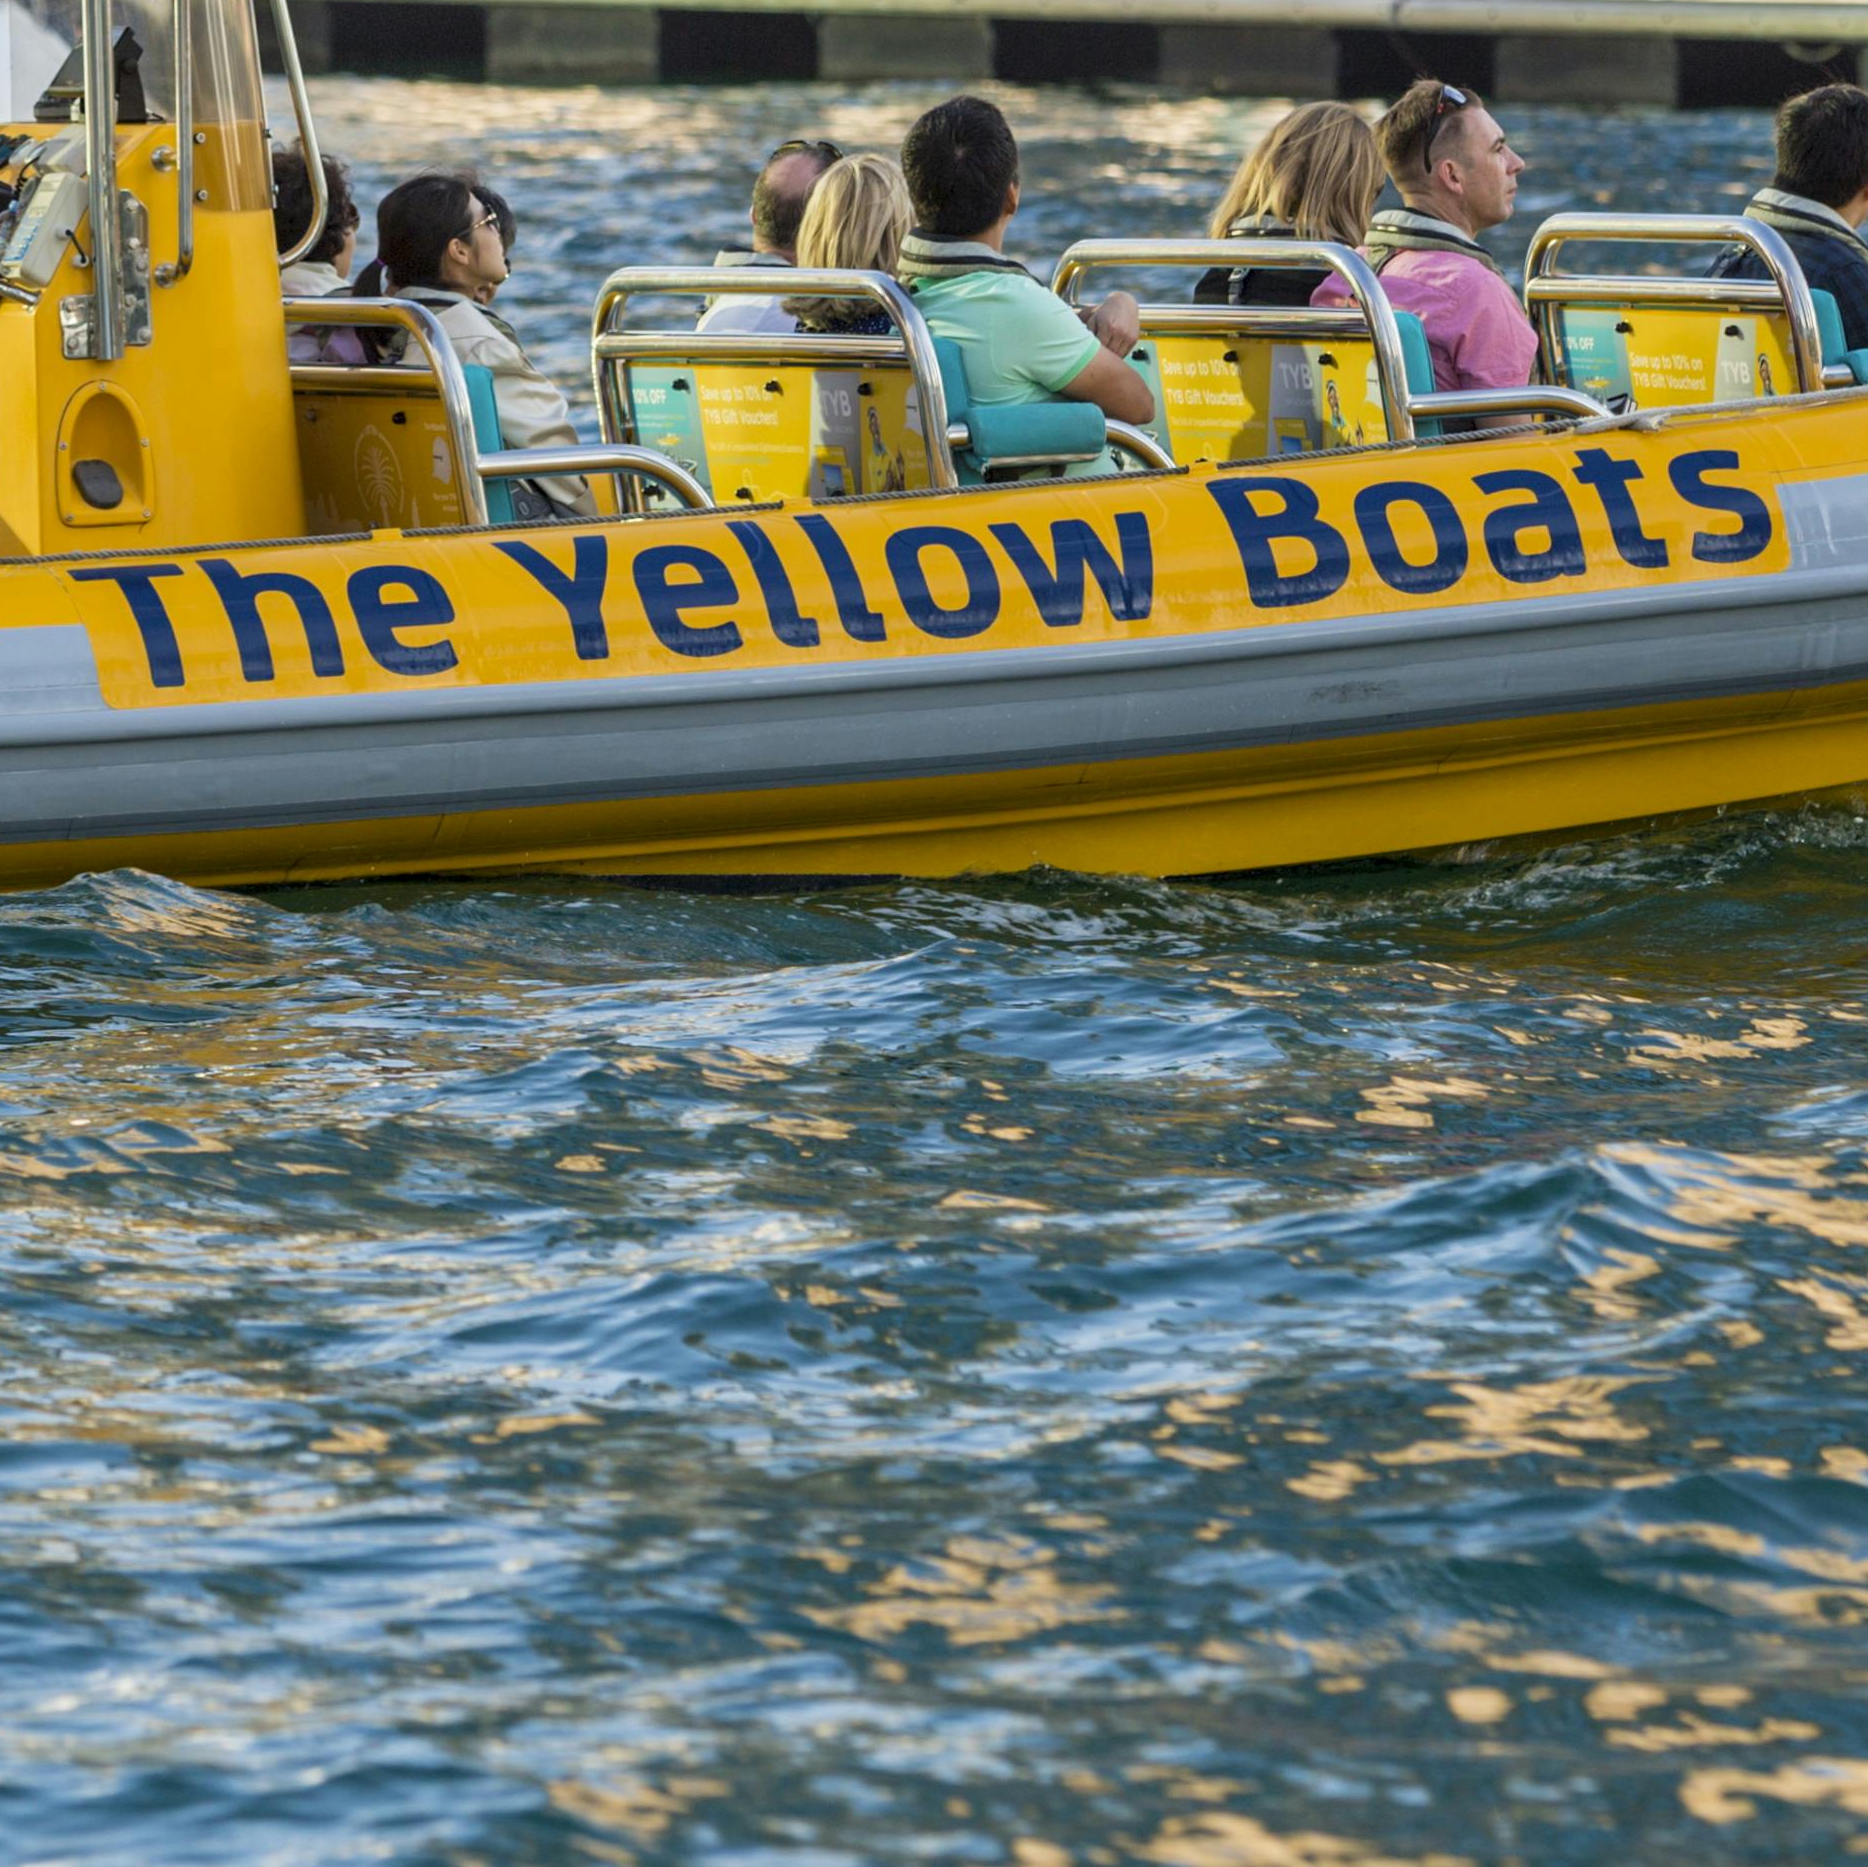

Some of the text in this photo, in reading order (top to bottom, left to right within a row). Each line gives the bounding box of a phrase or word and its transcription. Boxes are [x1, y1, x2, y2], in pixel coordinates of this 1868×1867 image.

[1162, 357, 1182, 375] Save
[1184, 362, 1196, 378] up
[1197, 360, 1209, 376] to
[1210, 359, 1230, 376] 10%
[1630, 352, 1649, 368] Save
[1651, 356, 1661, 370] up
[1662, 354, 1671, 369] to
[1671, 354, 1690, 370] 10%
[1691, 358, 1703, 371] on
[1279, 363, 1313, 390] TYB
[1634, 372, 1650, 388] TYB
[1651, 372, 1666, 389] Gift
[1721, 360, 1751, 385] TYB
[649, 388, 667, 405] OFF
[700, 385, 720, 401] Save
[723, 388, 733, 404] up
[734, 387, 743, 401] to
[743, 386, 761, 401] 10%
[818, 389, 852, 417] TYB
[1166, 388, 1184, 405] TYB
[1186, 388, 1203, 405] Gift
[704, 408, 721, 425] TYB
[722, 408, 738, 425] Gift
[68, 447, 1773, 689] The Yellow Boats
